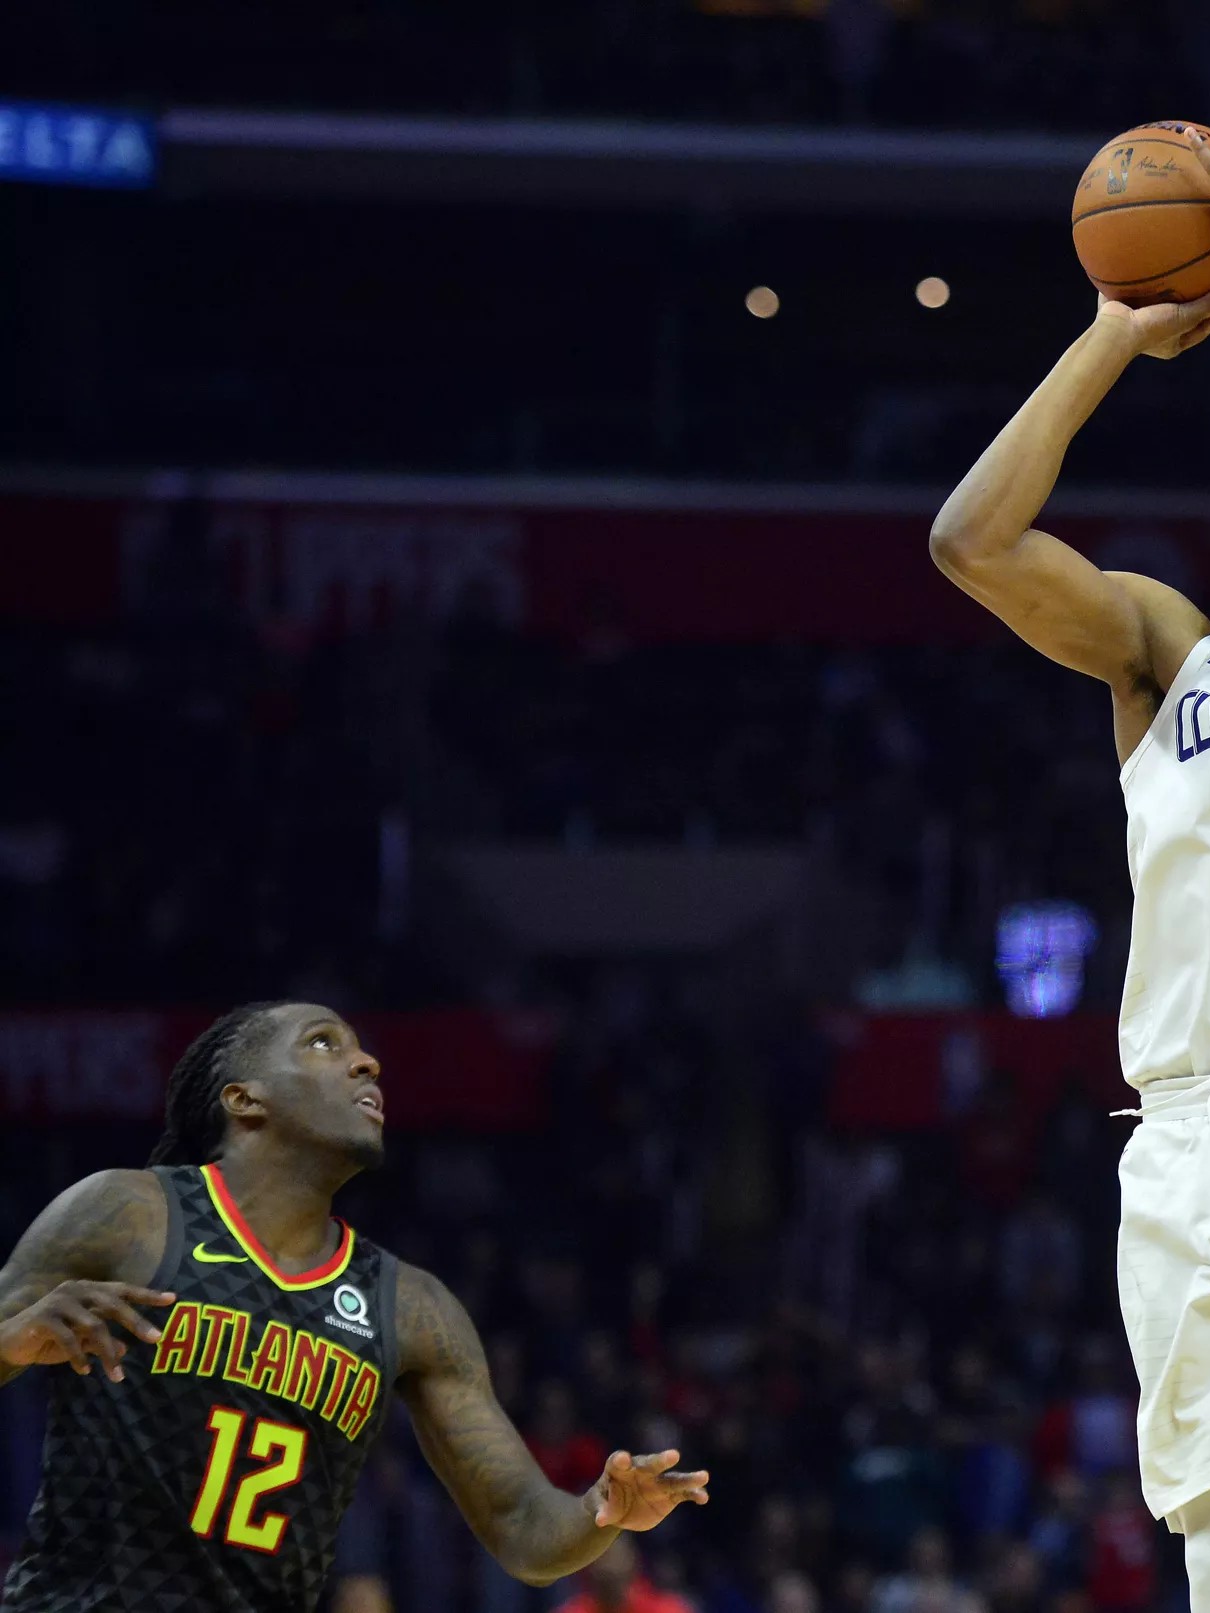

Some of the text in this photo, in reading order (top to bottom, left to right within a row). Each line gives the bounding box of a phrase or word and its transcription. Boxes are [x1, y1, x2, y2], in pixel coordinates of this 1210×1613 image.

[151, 1302, 381, 1442] ATLANTA
[324, 1314, 375, 1339] sharecare
[190, 1405, 309, 1556] 12
